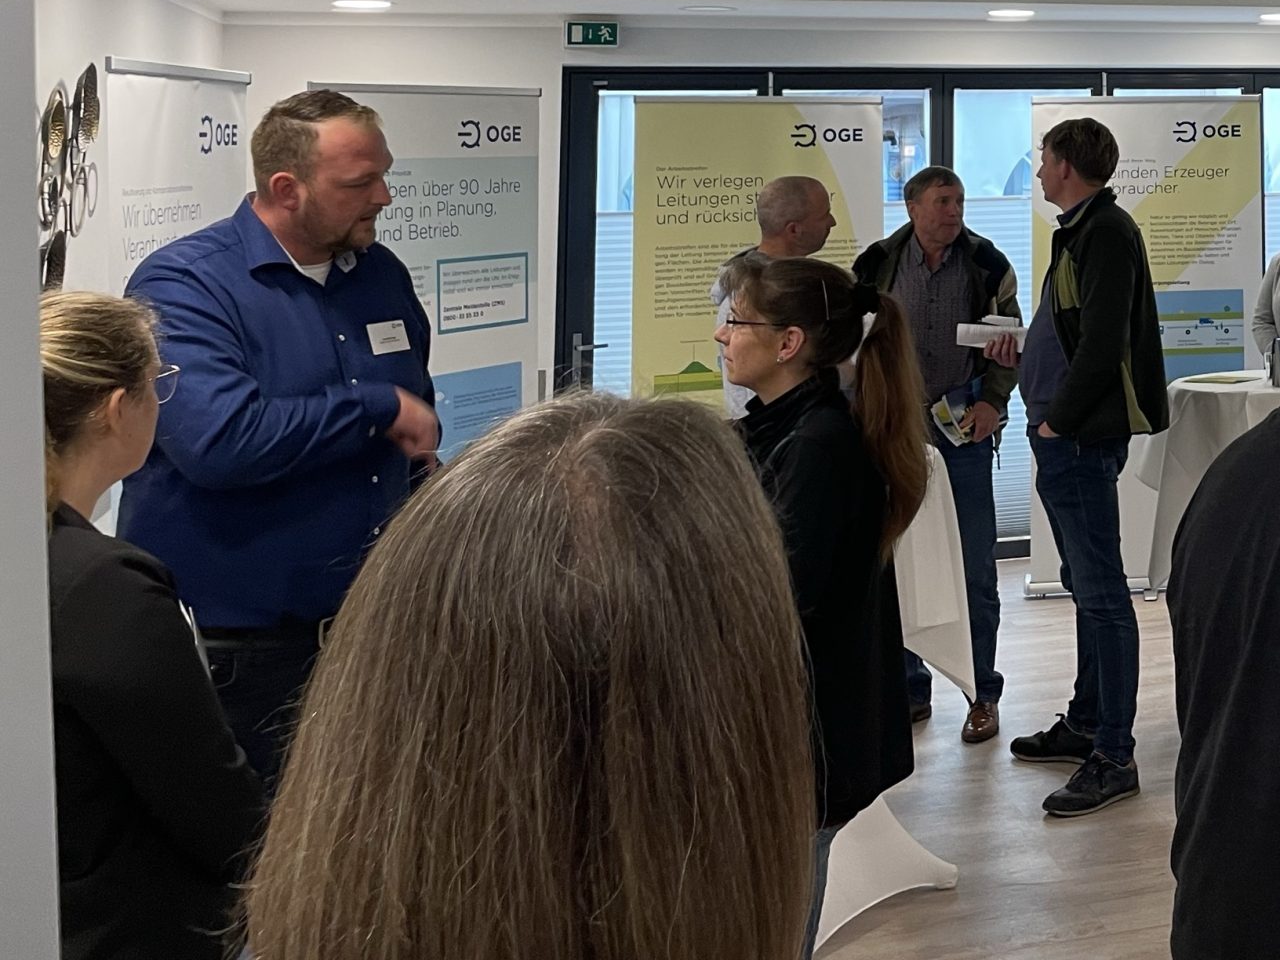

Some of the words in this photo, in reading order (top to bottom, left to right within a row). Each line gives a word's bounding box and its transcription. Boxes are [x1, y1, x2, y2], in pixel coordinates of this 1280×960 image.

[215, 123, 238, 146] OGE
[486, 125, 521, 142] OGE
[822, 128, 863, 142] OGE
[1202, 125, 1241, 138] OGE
[1164, 166, 1229, 181] Erzeuger
[388, 182, 417, 198] ben
[422, 180, 455, 197] über
[459, 178, 480, 196] 90
[484, 178, 521, 195] Jahre
[657, 175, 687, 189] Wir
[693, 174, 764, 190] verlegen
[1112, 182, 1180, 195] braucher.
[657, 192, 740, 208] Leitungen
[122, 205, 141, 229] Wir
[143, 202, 201, 227] übernehmen
[419, 202, 431, 219] in
[437, 201, 497, 218] Planung,
[656, 210, 689, 225] und
[408, 222, 462, 241] Betrieb.
